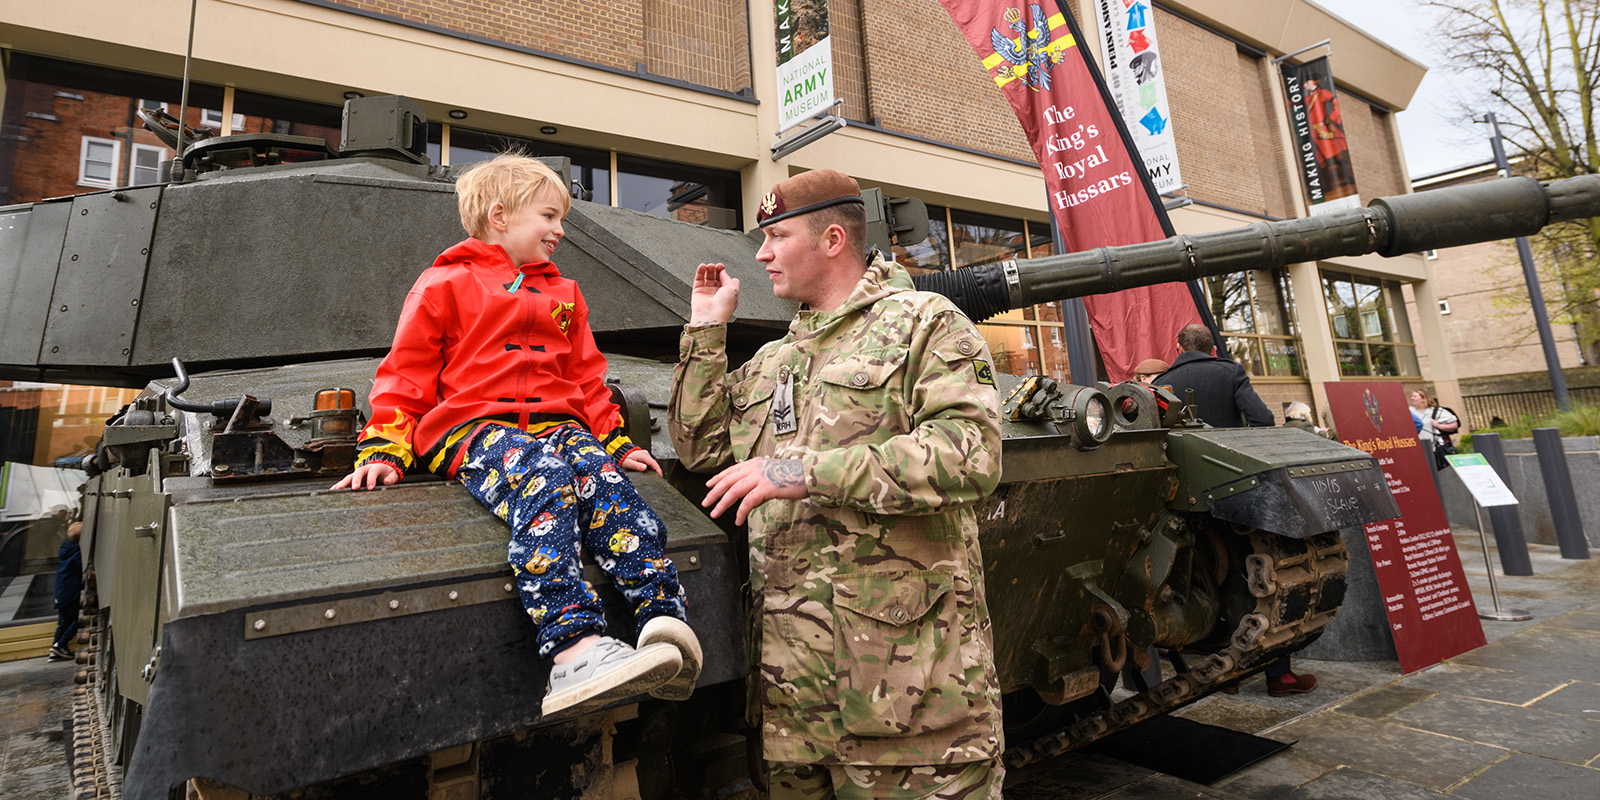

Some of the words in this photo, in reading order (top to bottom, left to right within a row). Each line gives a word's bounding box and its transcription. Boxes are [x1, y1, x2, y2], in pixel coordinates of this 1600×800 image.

[1100, 0, 1118, 70] PERSUASIO
[1115, 21, 1125, 48] ABRAM
[783, 56, 826, 86] NATIONAL
[784, 67, 827, 107] ARMY
[785, 90, 828, 122] MUSEUM
[1043, 105, 1076, 126] The
[1287, 76, 1309, 137] HISTORY
[1045, 124, 1099, 157] King's
[1053, 144, 1110, 180] Royal
[1146, 153, 1170, 166] ONAL
[1149, 162, 1171, 180] MY
[1302, 142, 1323, 200] MAKING
[1053, 171, 1133, 210] Hussars
[1356, 439, 1377, 455] King's
[1375, 437, 1394, 453] Royal
[1391, 436, 1417, 448] Hussars
